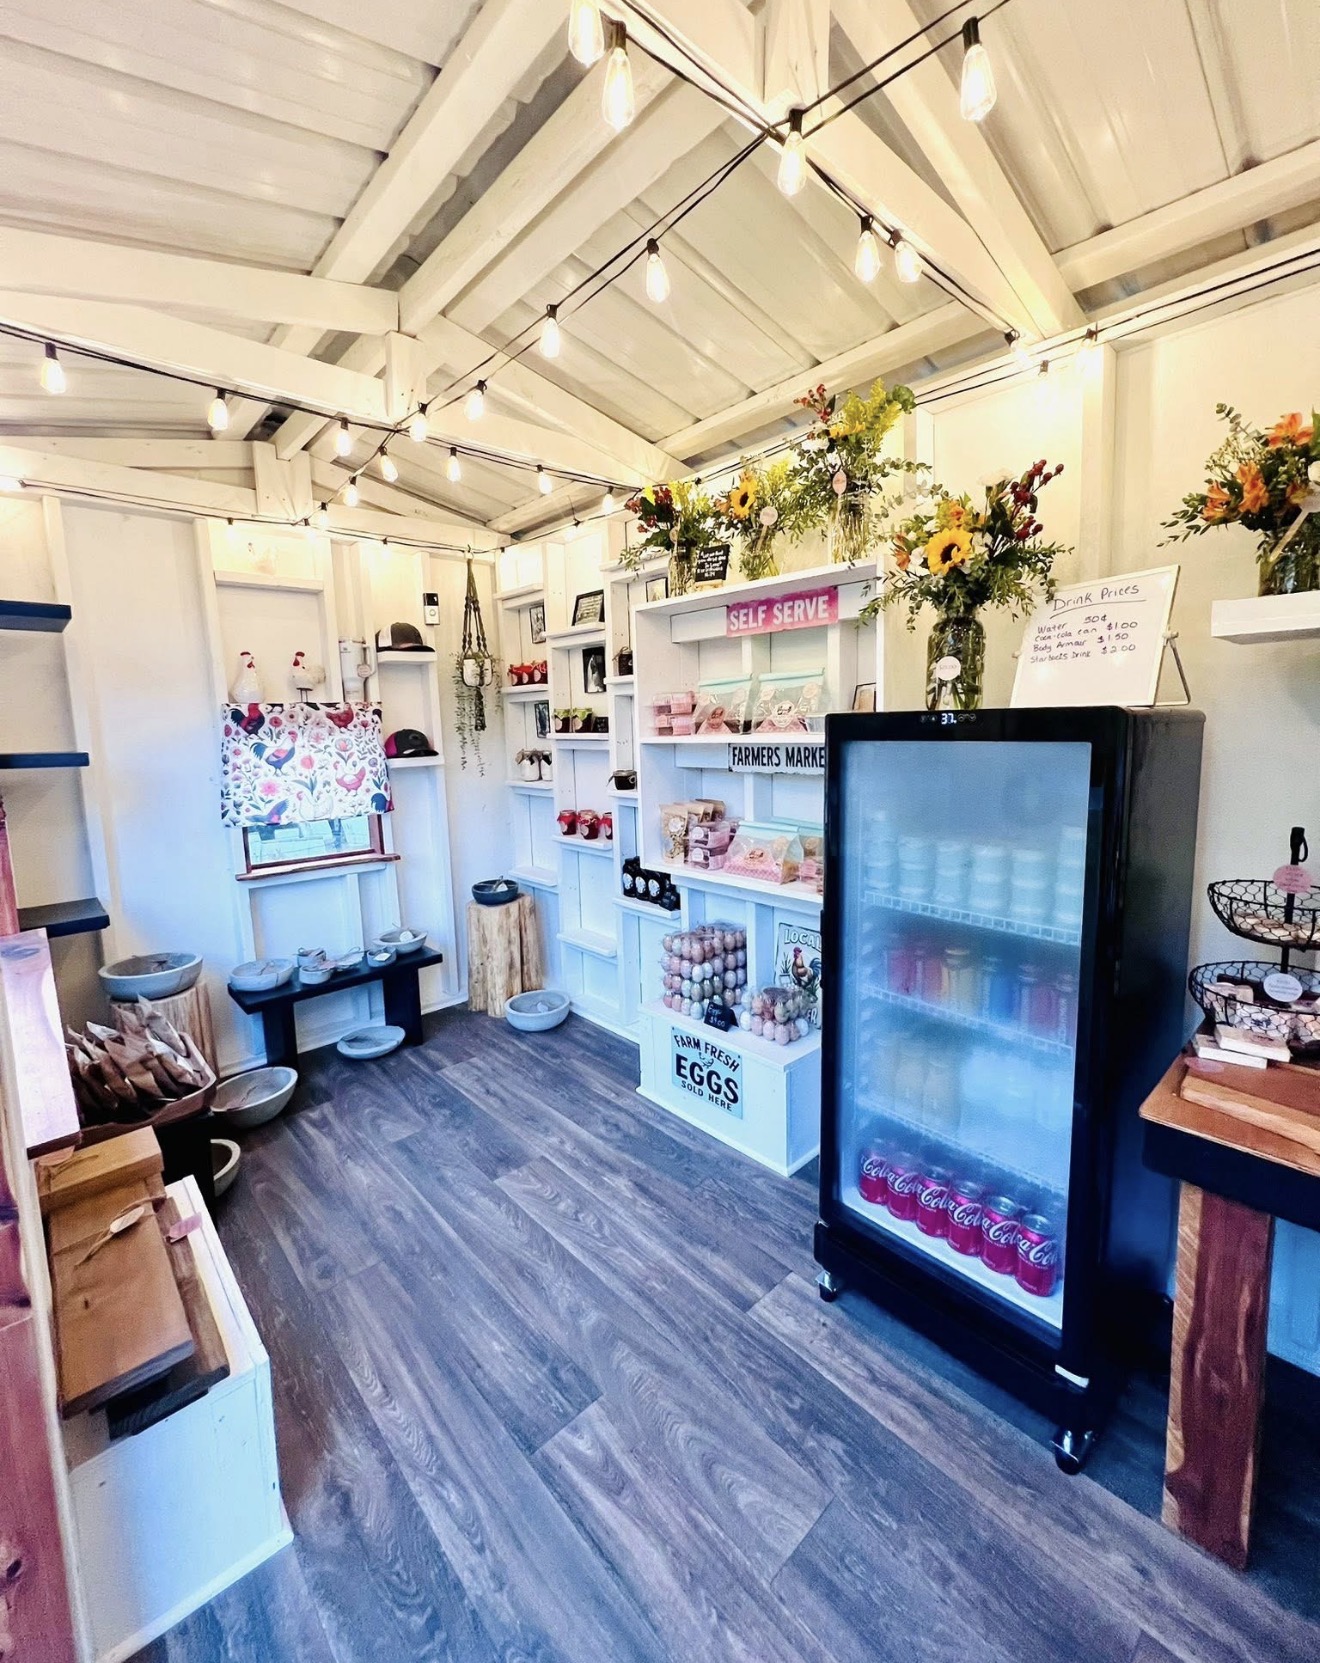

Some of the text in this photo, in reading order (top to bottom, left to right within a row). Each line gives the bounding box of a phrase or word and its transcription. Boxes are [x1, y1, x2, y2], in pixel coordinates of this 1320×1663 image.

[730, 595, 829, 631] SELF SERVE
[1052, 584, 1139, 612] Drink Prices
[1037, 622, 1068, 635] Water
[732, 746, 825, 768] FARMERS MARKE
[674, 1035, 740, 1072] FARM FRESH
[675, 1053, 739, 1104] EGGS
[681, 1080, 732, 1112] SOLD HERE
